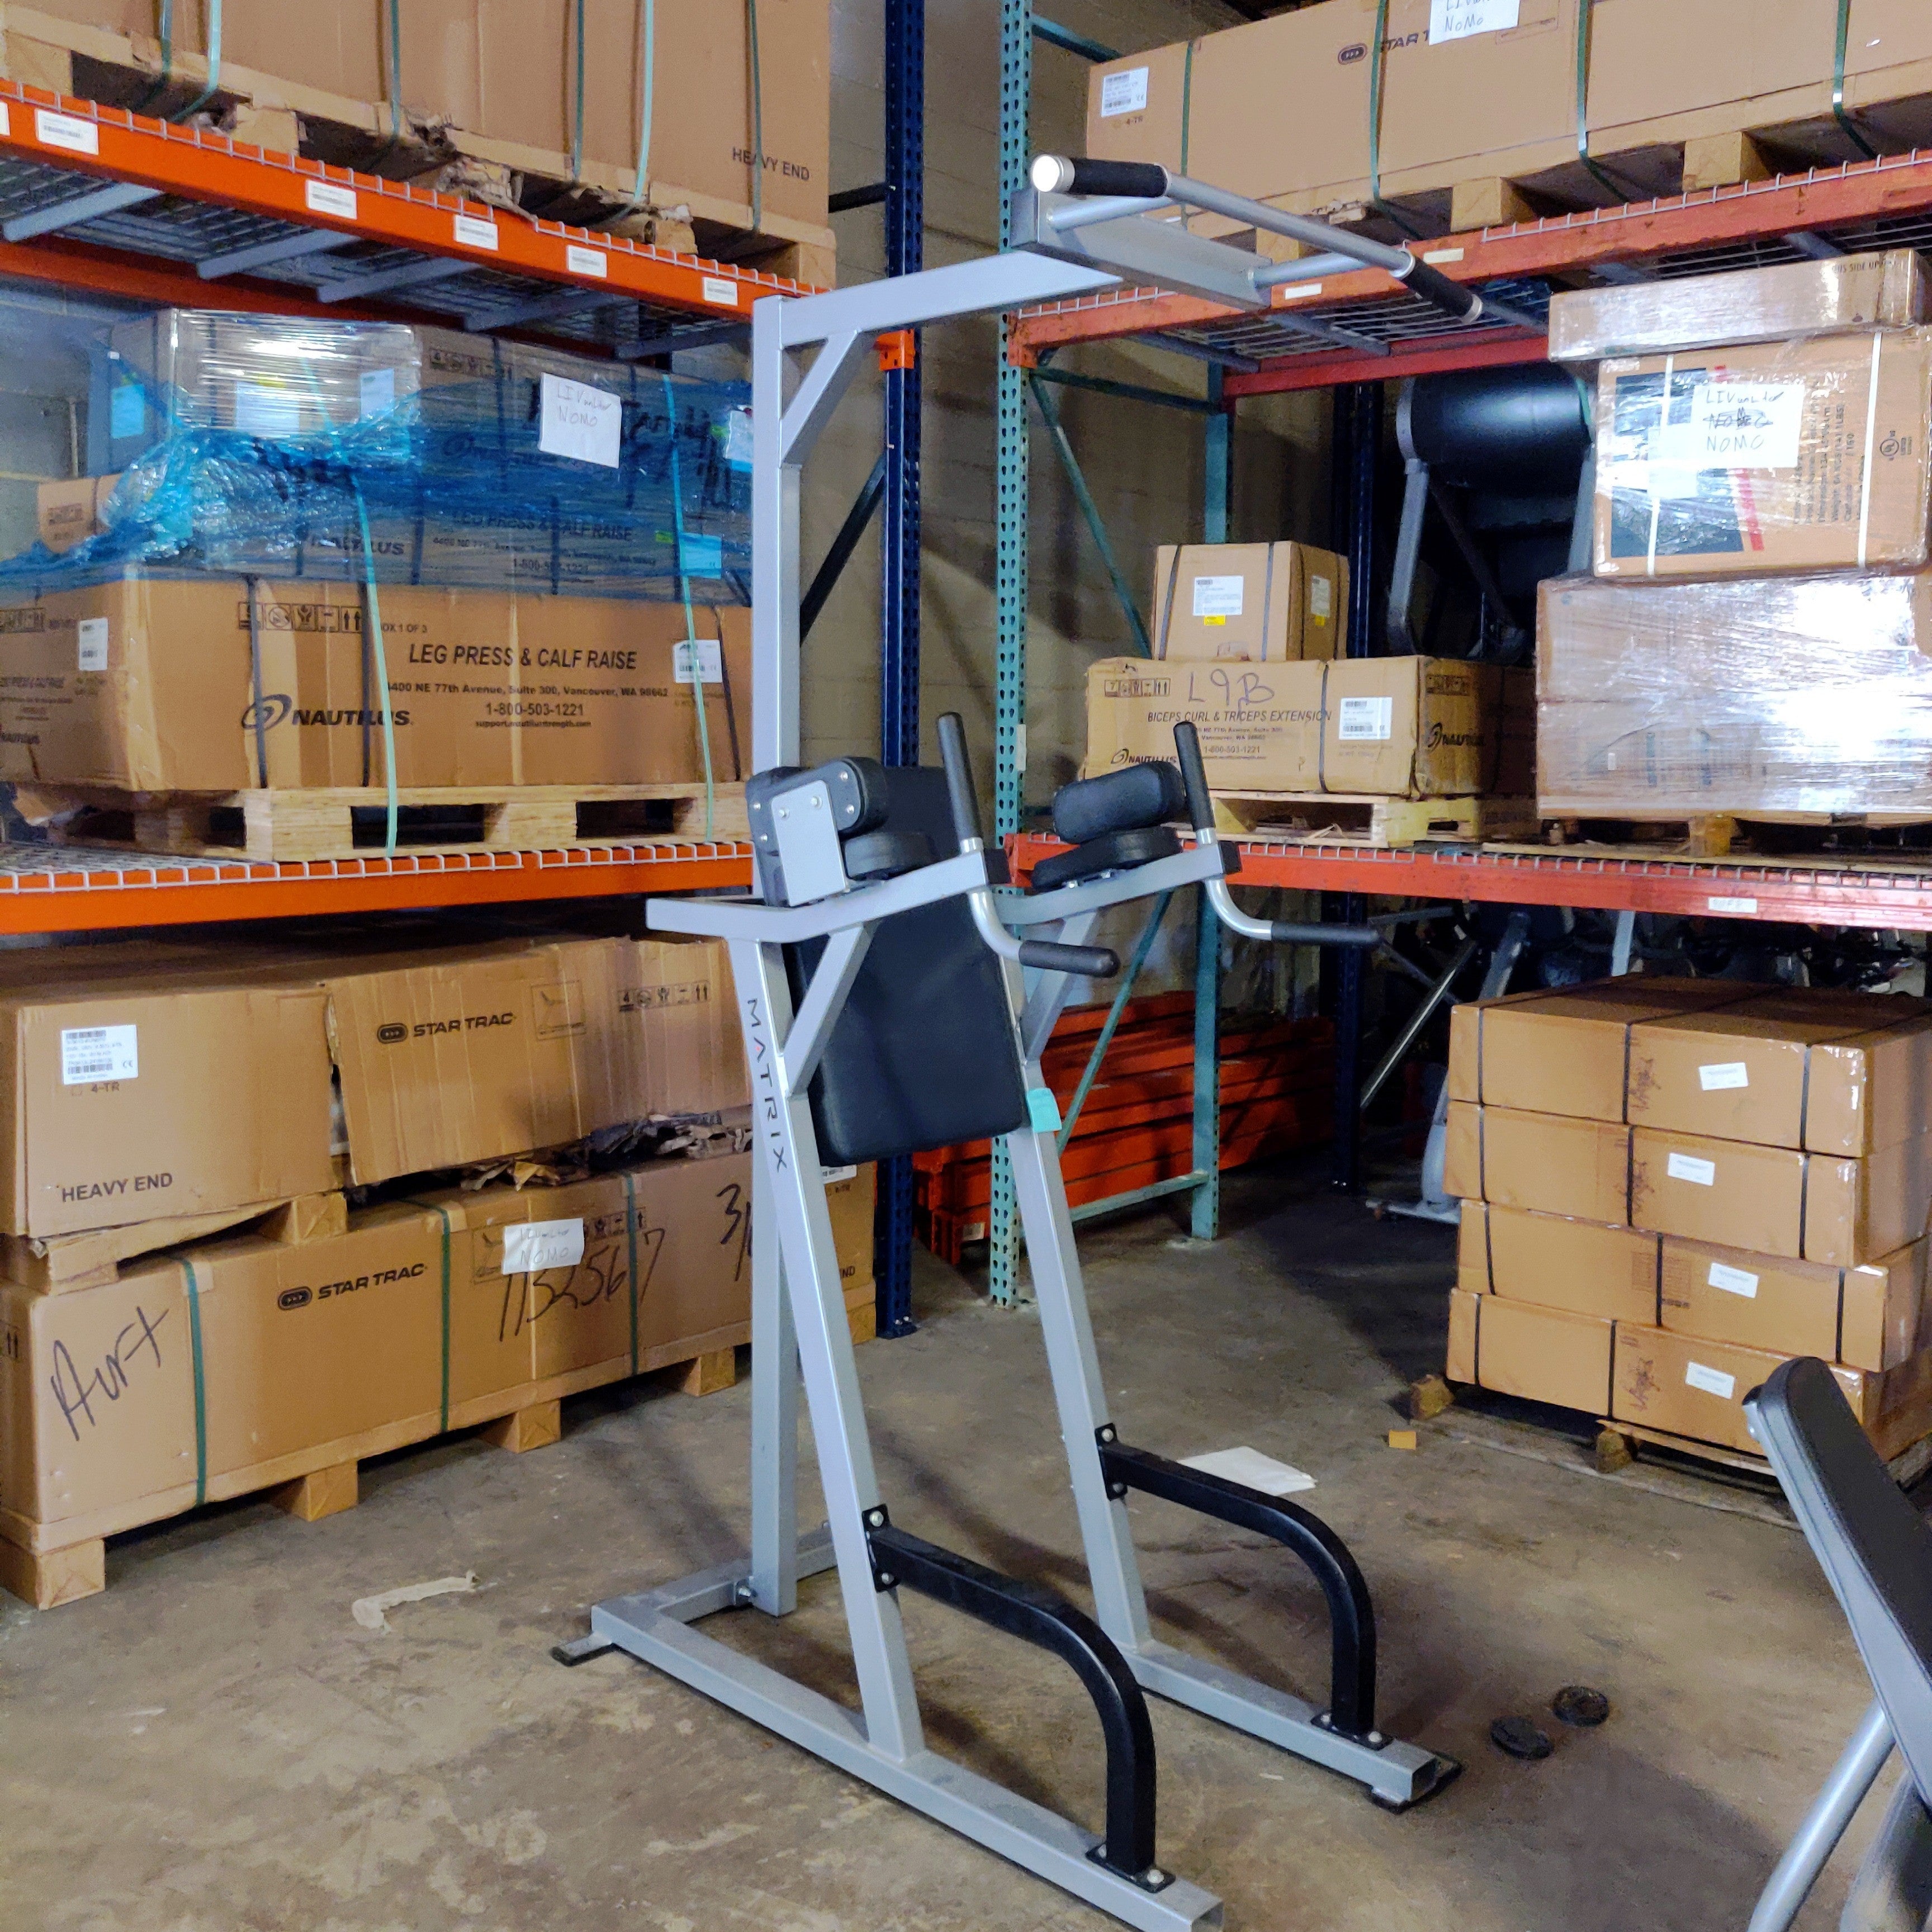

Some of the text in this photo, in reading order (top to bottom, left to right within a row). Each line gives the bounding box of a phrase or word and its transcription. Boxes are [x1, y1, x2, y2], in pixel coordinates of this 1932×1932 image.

[783, 161, 810, 181] END
[407, 624, 418, 633] OF
[409, 644, 637, 669] LEG PRESS & CALF RAISE
[415, 683, 430, 692] NE
[435, 683, 458, 693] 77th
[621, 688, 636, 696] WA
[485, 702, 583, 716] 1-800-503-1221
[1148, 711, 1181, 722] BICEPS
[1185, 712, 1210, 722] CURL
[1214, 712, 1220, 721] &
[1224, 711, 1267, 722] TRICEPS
[413, 1012, 513, 1037] STAR TRAC
[747, 998, 787, 1173] MATRIX
[62, 1173, 173, 1202] HEAVY END
[318, 1263, 424, 1300] STAR TRAC
